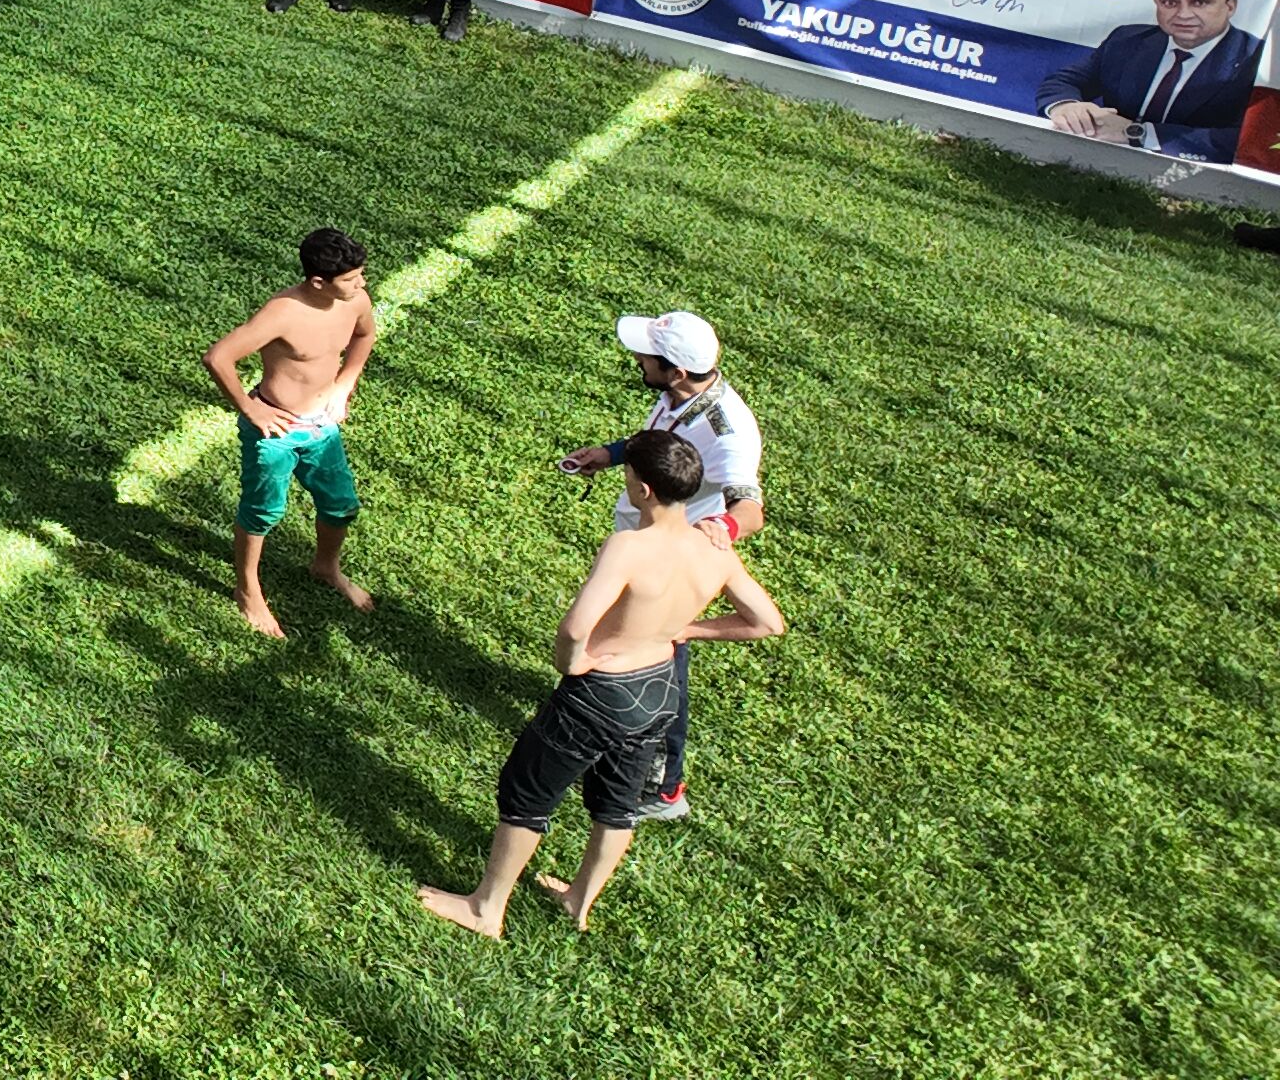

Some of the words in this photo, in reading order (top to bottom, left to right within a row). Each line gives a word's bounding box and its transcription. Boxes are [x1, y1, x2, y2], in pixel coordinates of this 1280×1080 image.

[821, 35, 890, 60] Muhtarlar
[890, 51, 939, 71] Dernek
[940, 63, 997, 84] Başkanı
[879, 23, 984, 67] UĞUR
